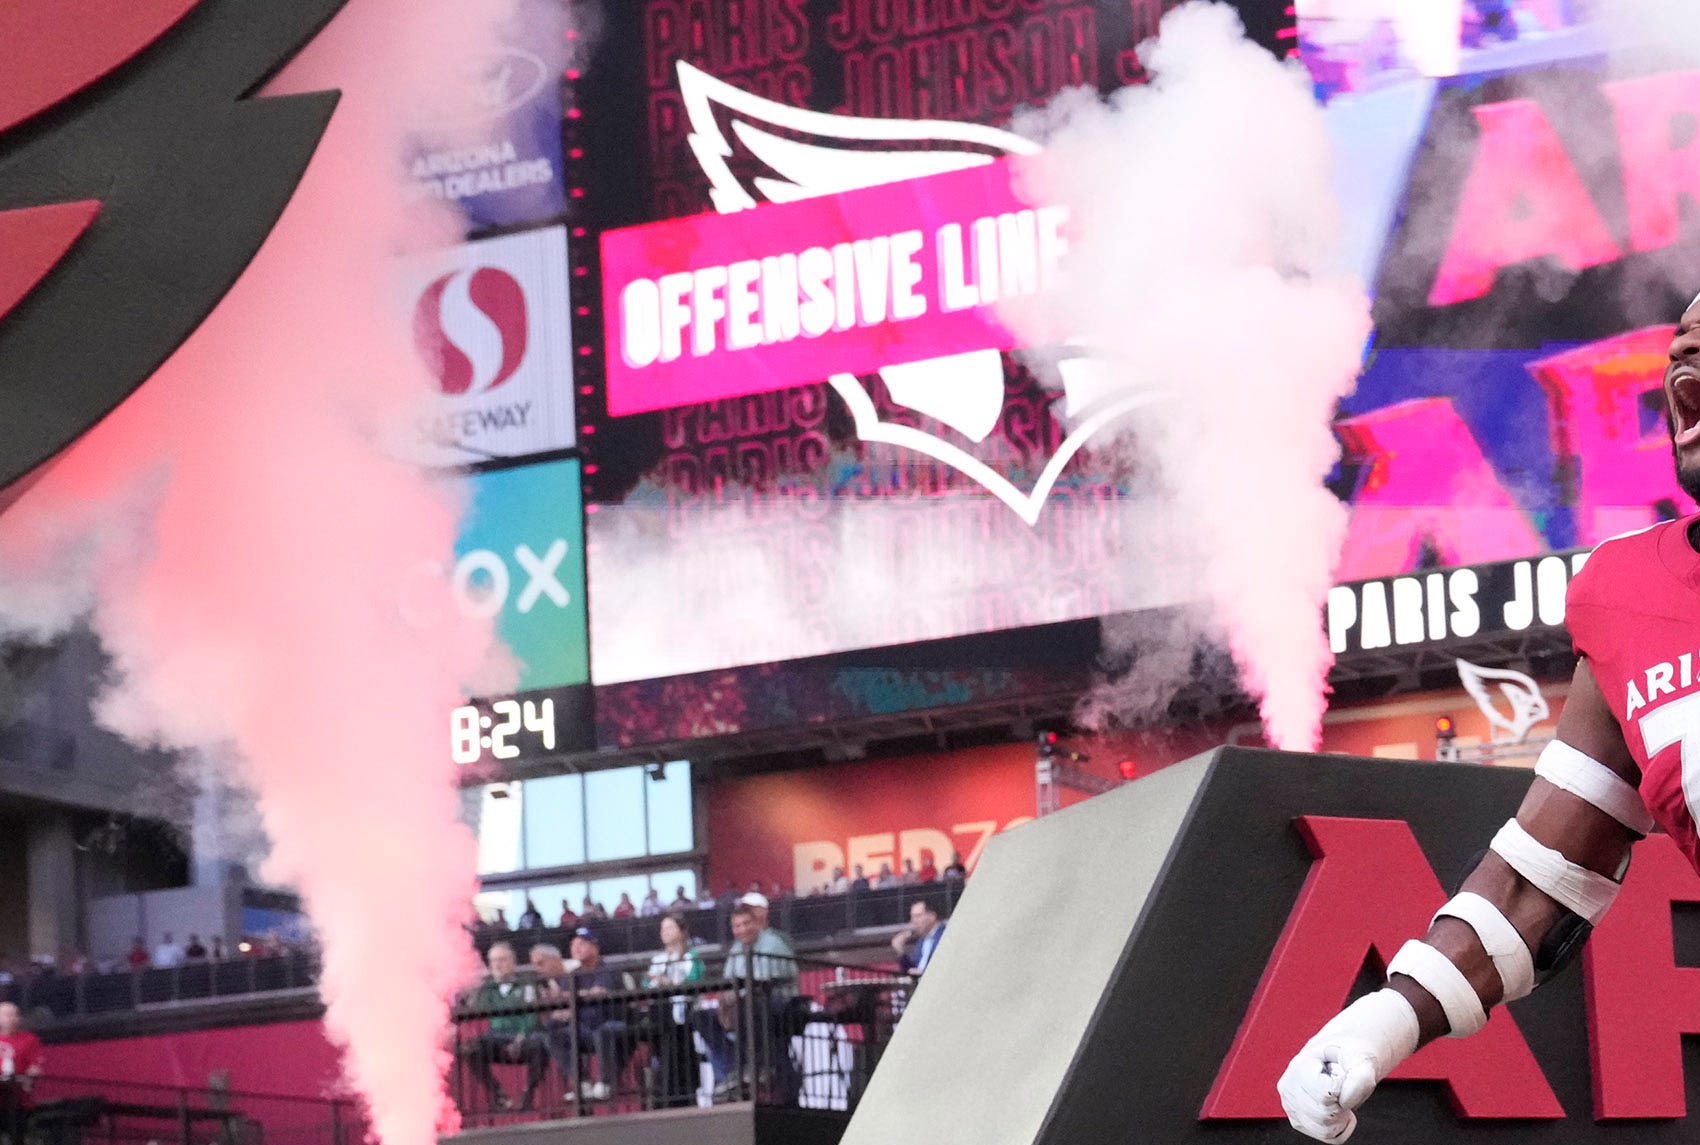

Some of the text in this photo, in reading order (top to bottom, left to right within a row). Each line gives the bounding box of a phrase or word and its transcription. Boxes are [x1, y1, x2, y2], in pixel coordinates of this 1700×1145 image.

[620, 205, 1071, 369] OFFENSIVE LINE
[1327, 552, 1592, 653] PARIS JO
[450, 698, 556, 765] 8:24
